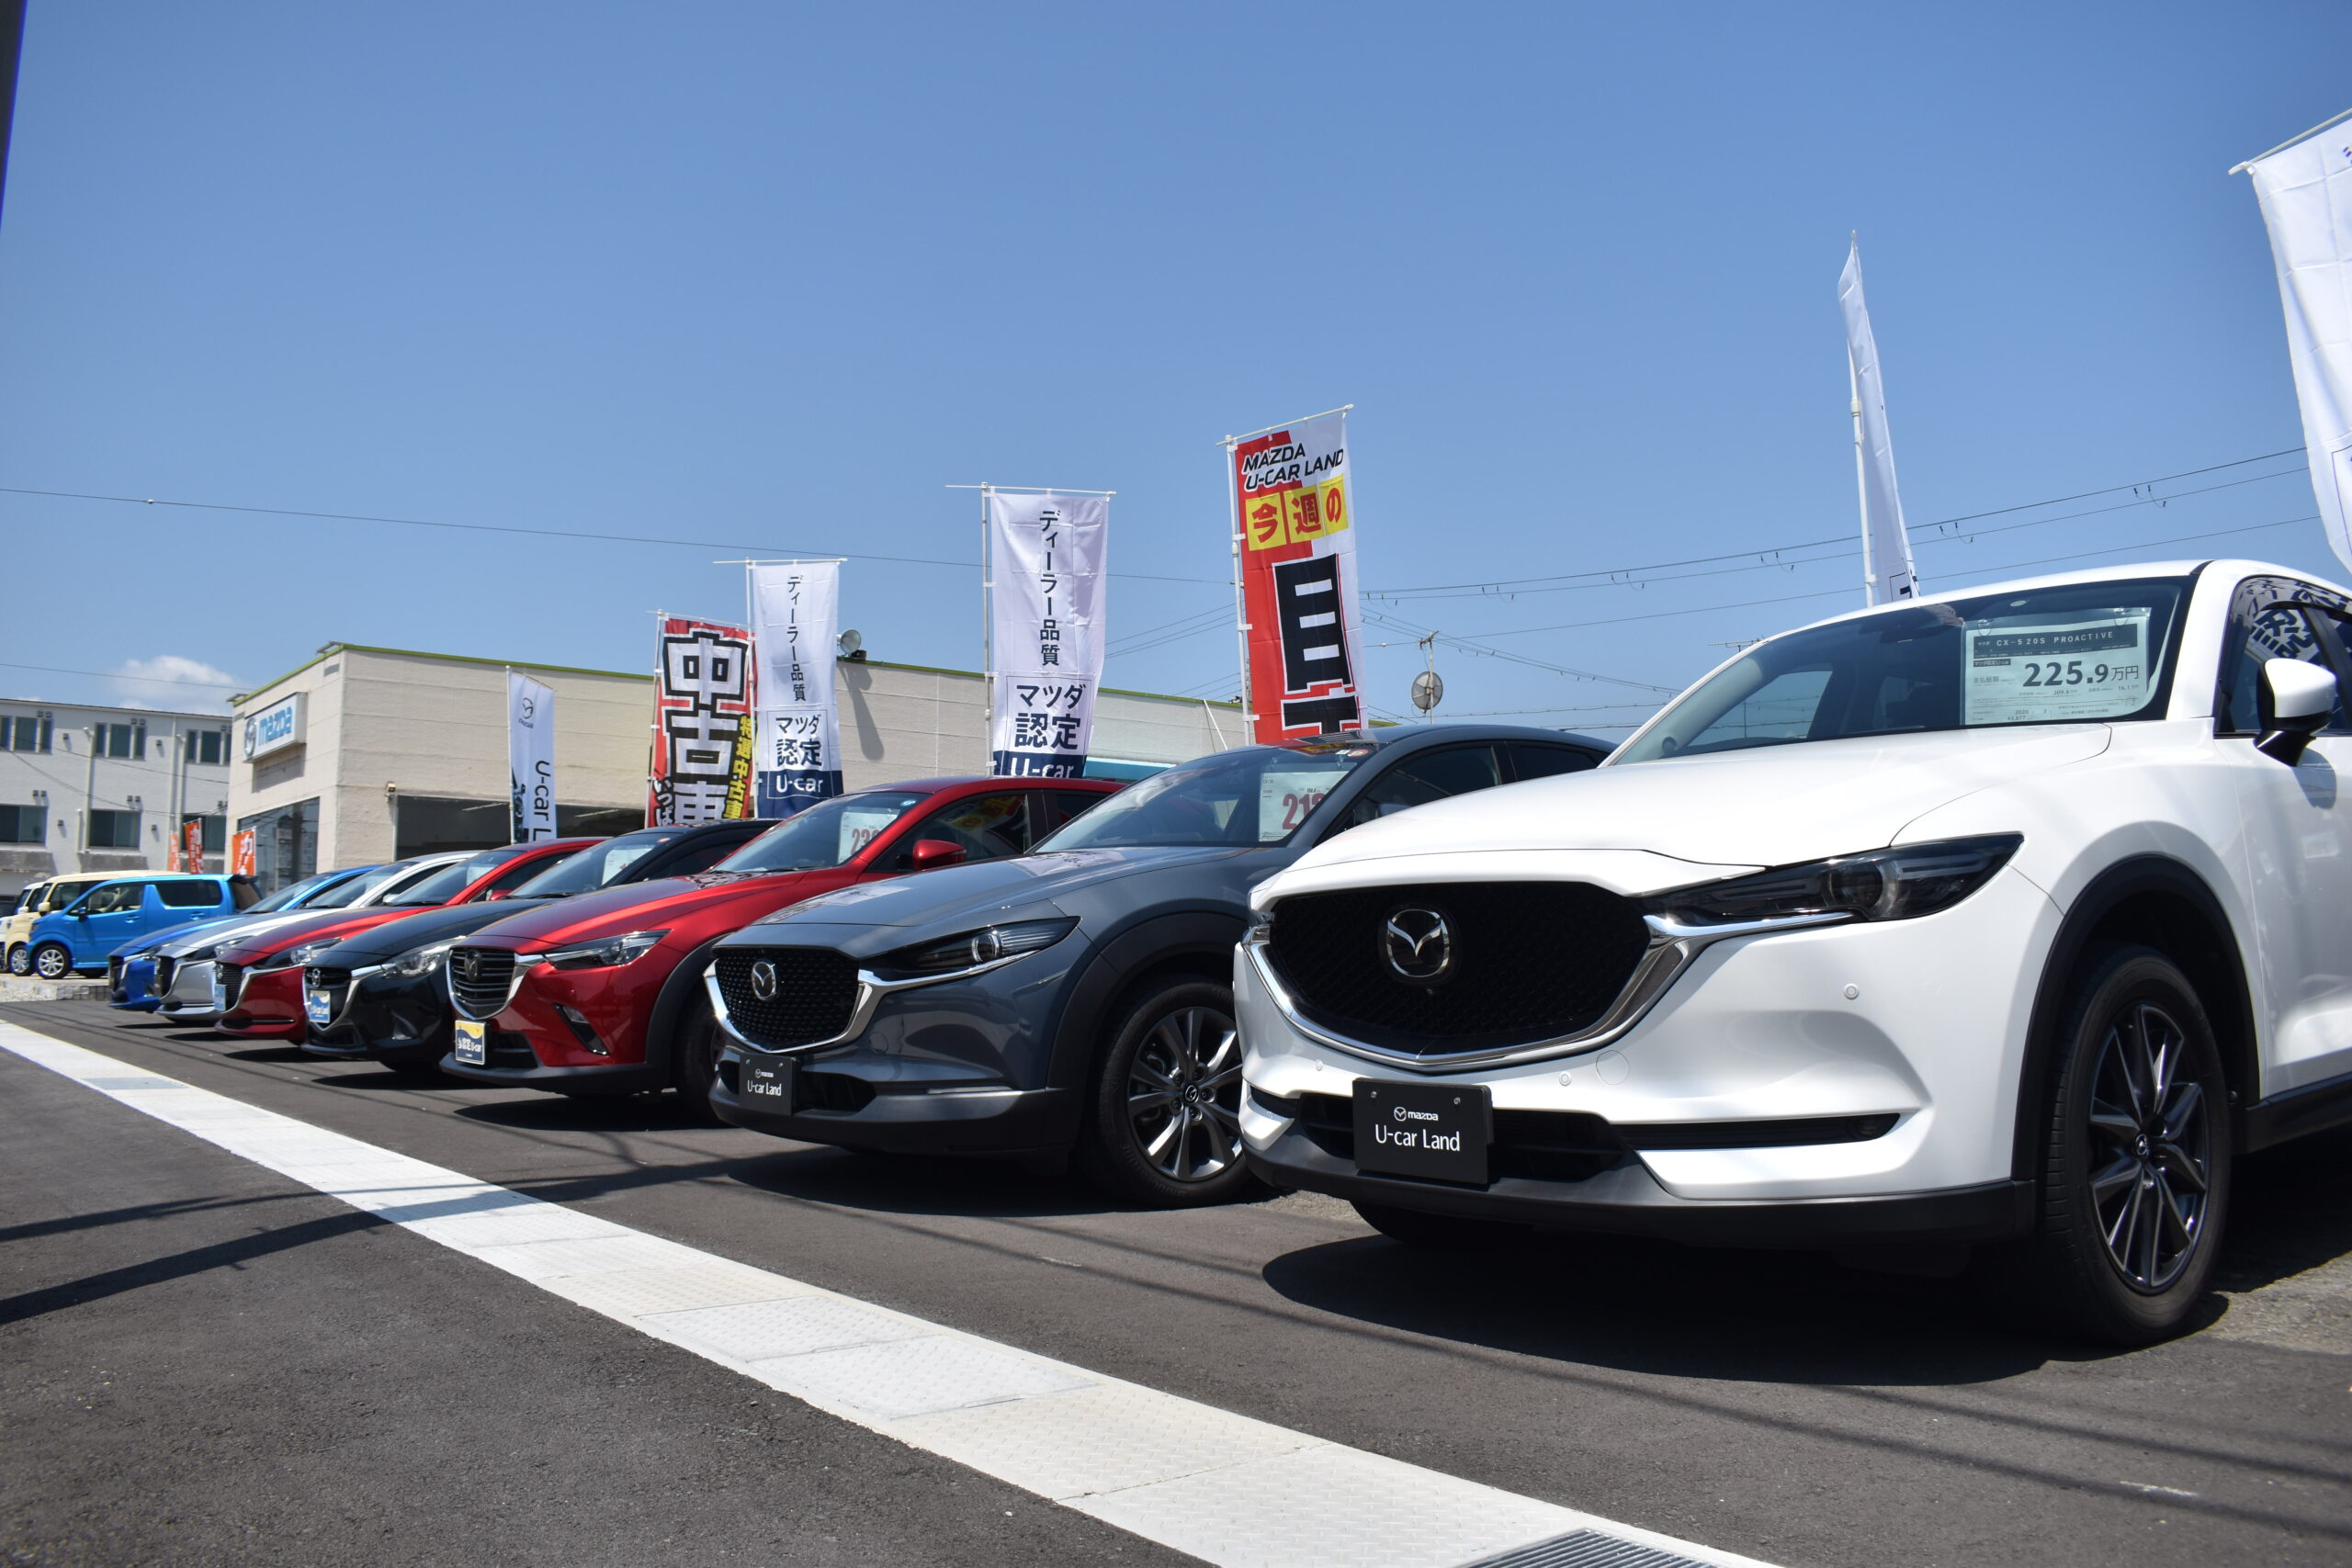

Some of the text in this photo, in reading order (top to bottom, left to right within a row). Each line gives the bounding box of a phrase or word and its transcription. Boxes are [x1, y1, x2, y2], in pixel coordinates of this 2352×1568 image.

[1243, 443, 1306, 473] MAZDA
[1246, 448, 1344, 491] U-CAR LAND
[1251, 487, 1342, 543] 今週の
[1039, 509, 1061, 666] ディーラー品質
[786, 576, 806, 702] ディーラー品質
[2053, 631, 2113, 643] PROACTIVE
[1015, 683, 1087, 709] マツダ
[258, 705, 293, 746] mazda
[775, 714, 821, 735] マツダ
[1014, 712, 1081, 750] 認定
[776, 739, 822, 767] 認定
[1011, 757, 1074, 779] U-car
[533, 761, 551, 821] U-car
[775, 774, 823, 793] U-car
[747, 1079, 782, 1096] U-car Land
[1408, 1111, 1439, 1122] mazda
[1375, 1123, 1460, 1152] U-car Land
